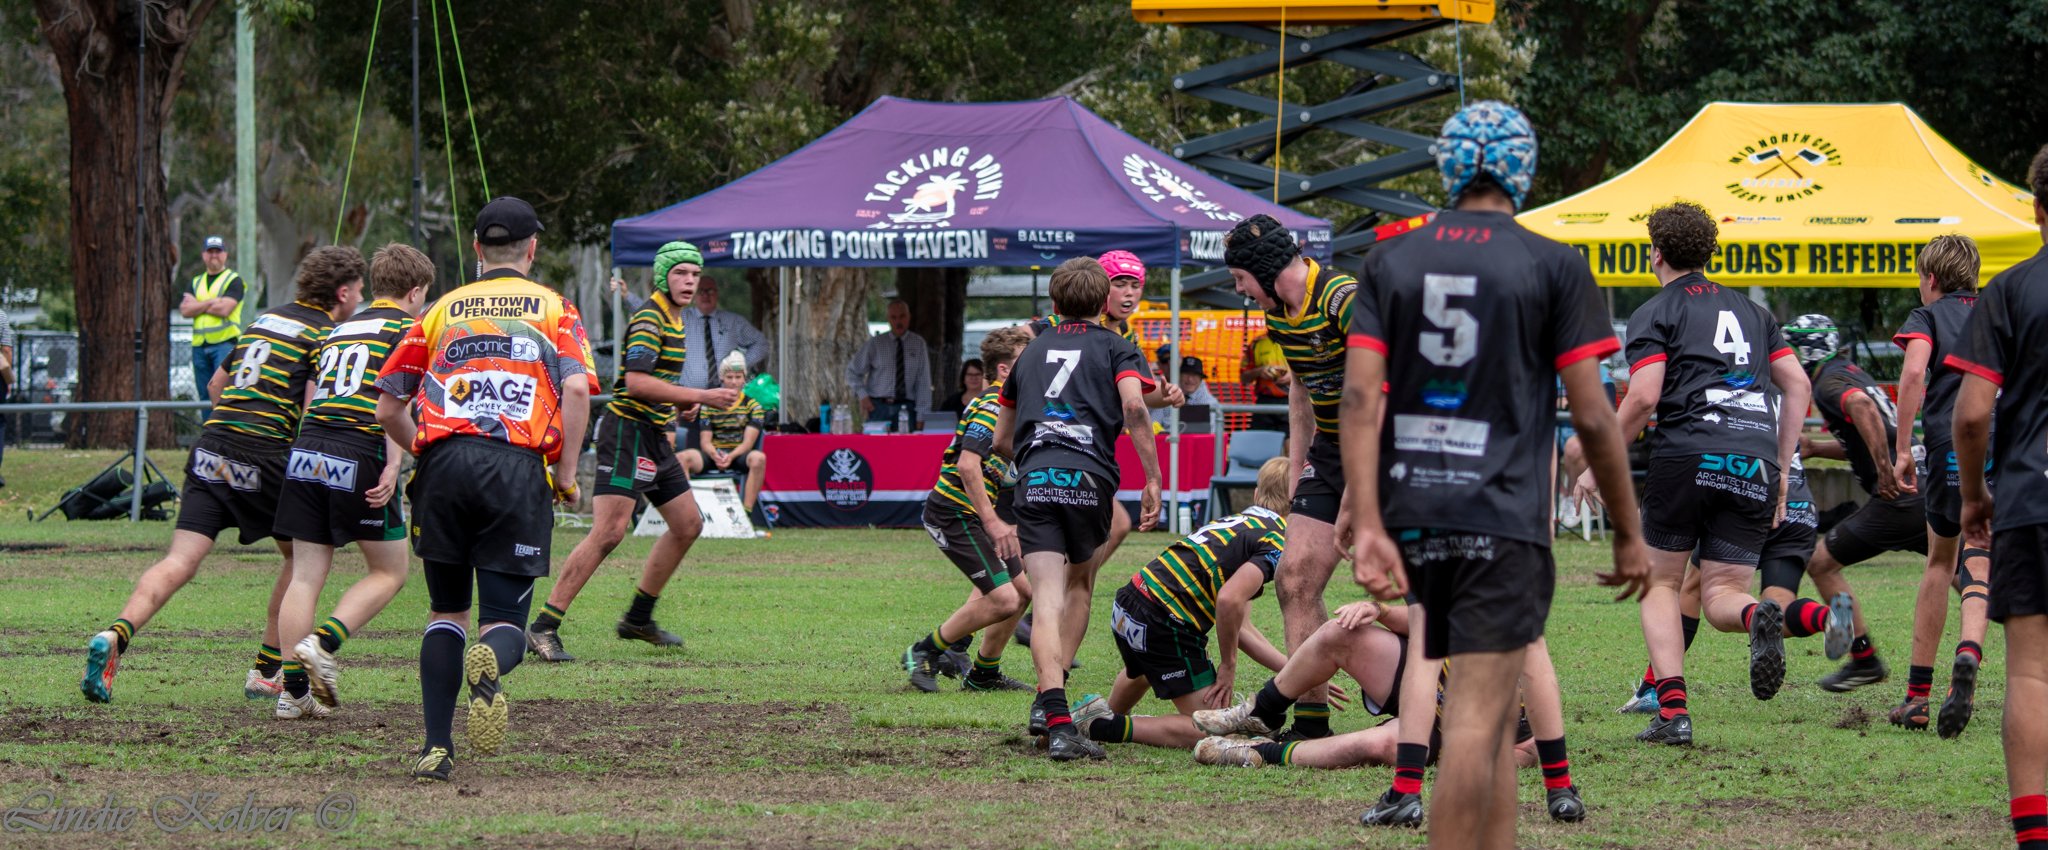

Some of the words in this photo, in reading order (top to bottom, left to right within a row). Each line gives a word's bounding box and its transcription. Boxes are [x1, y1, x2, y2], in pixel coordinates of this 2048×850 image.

[1729, 145, 1756, 164] MID
[1758, 133, 1811, 149] NORTH
[864, 146, 970, 202] TACKING
[968, 153, 1003, 201] POINT
[1776, 184, 1824, 203] UNION
[730, 230, 826, 260] TACKING
[831, 230, 898, 260] POINT
[903, 230, 989, 259] TAVERN
[1018, 229, 1076, 243] BALTER
[1435, 225, 1492, 244] 1973
[1598, 243, 1655, 275] NOR
[1808, 243, 1928, 275] REFERE
[449, 297, 485, 319] OUR
[489, 296, 541, 315] TOWN
[464, 307, 524, 319] FENCING
[1418, 273, 1480, 368] 5
[1057, 323, 1087, 335] 1973
[1713, 310, 1752, 366] 4
[235, 339, 272, 390] 8
[313, 342, 371, 400] 20
[1043, 349, 1082, 399] 7
[467, 377, 533, 407] PAGE
[1026, 487, 1099, 500] ARCHITECTURAL
[1695, 471, 1769, 496] ARCHITECTURAL
